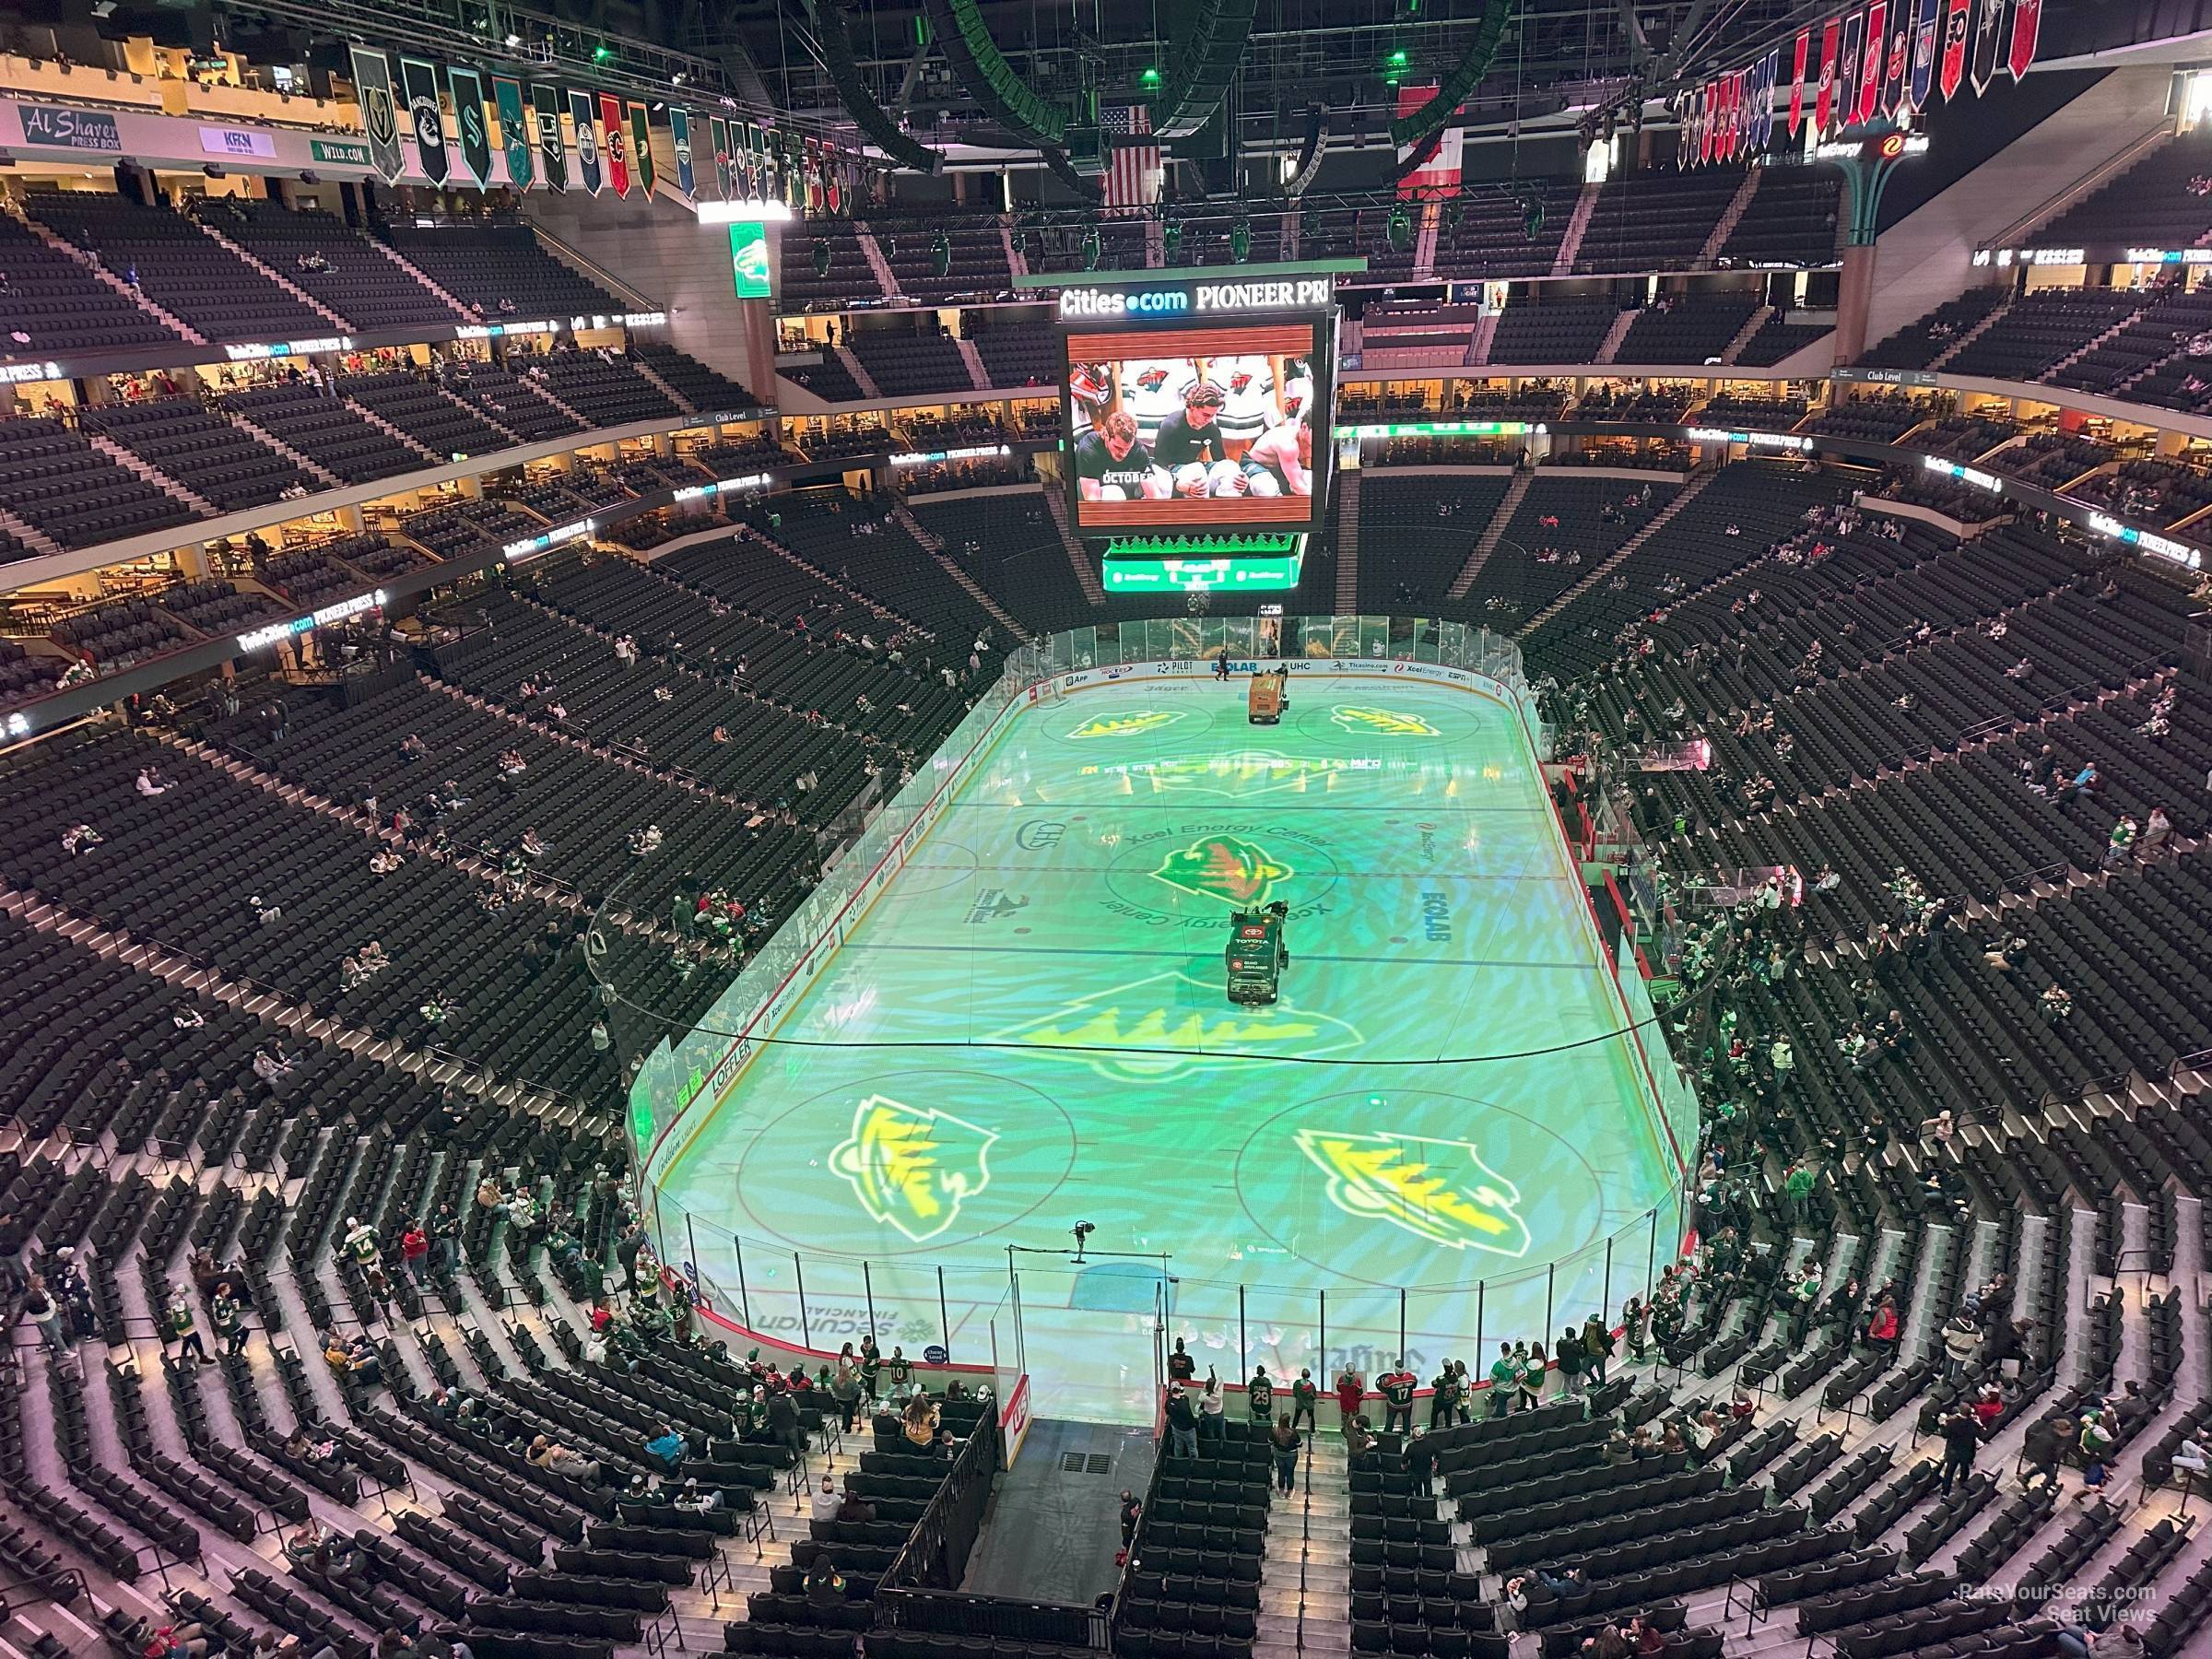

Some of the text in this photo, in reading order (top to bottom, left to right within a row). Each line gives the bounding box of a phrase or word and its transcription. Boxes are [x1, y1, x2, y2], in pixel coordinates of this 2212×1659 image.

[28, 108, 117, 138] Al Shaver
[71, 135, 120, 149] PRESS BOX
[1195, 280, 1294, 310] PIONEER
[1867, 371, 1901, 382] Club Level
[715, 414, 729, 423] Club
[729, 411, 747, 421] Level
[1290, 662, 1311, 670] UHC
[1125, 824, 1335, 848] Xcel Energy Center
[1421, 892, 1453, 942] ECOLAB
[712, 1038, 751, 1094] LOFFLER
[356, 1239, 373, 1254] 14
[891, 1367, 903, 1380] 10
[1253, 1391, 1269, 1406] 29
[1397, 1388, 1408, 1400] 17
